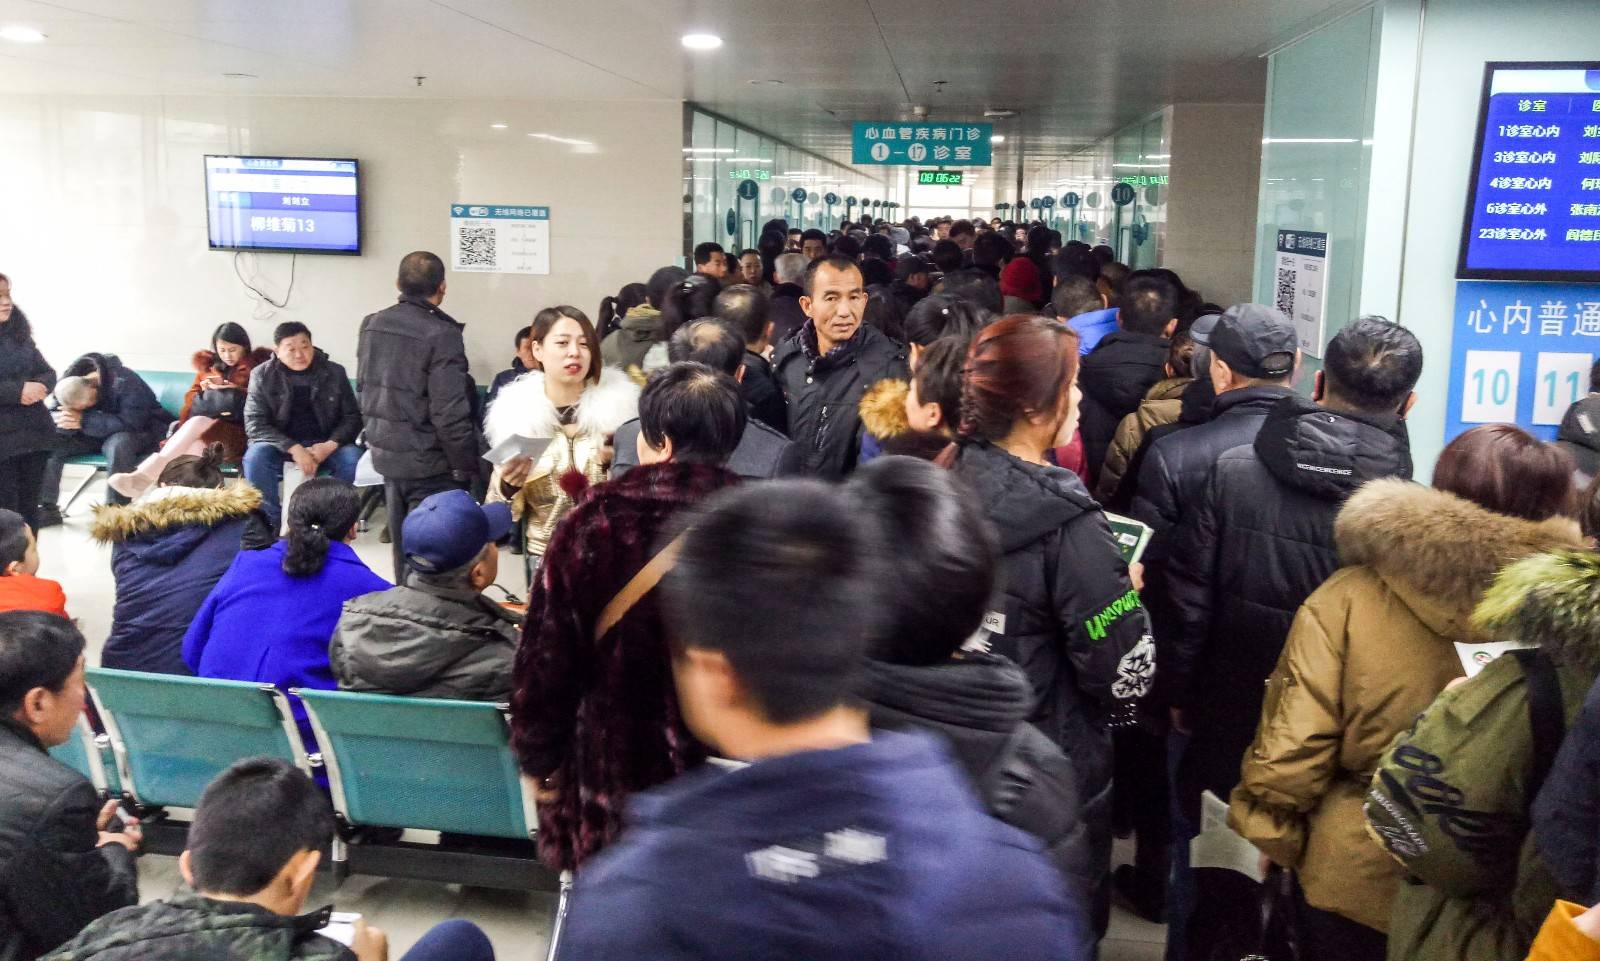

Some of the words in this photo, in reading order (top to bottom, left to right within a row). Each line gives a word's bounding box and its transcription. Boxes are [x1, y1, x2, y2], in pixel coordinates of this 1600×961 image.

[1517, 100, 1548, 112] 诊室
[864, 127, 981, 141] 心血管疾病门诊
[1498, 125, 1560, 138] 1诊室心内
[1493, 151, 1556, 164] 3诊室心内
[1490, 177, 1552, 190] 4诊室心内
[1486, 203, 1548, 216] 6诊室心外
[1570, 203, 1600, 216] 张南
[1478, 228, 1547, 241] 23诊室心外
[1466, 298, 1600, 337] 心内普通
[1472, 368, 1511, 406] 10
[1543, 370, 1580, 407] 11
